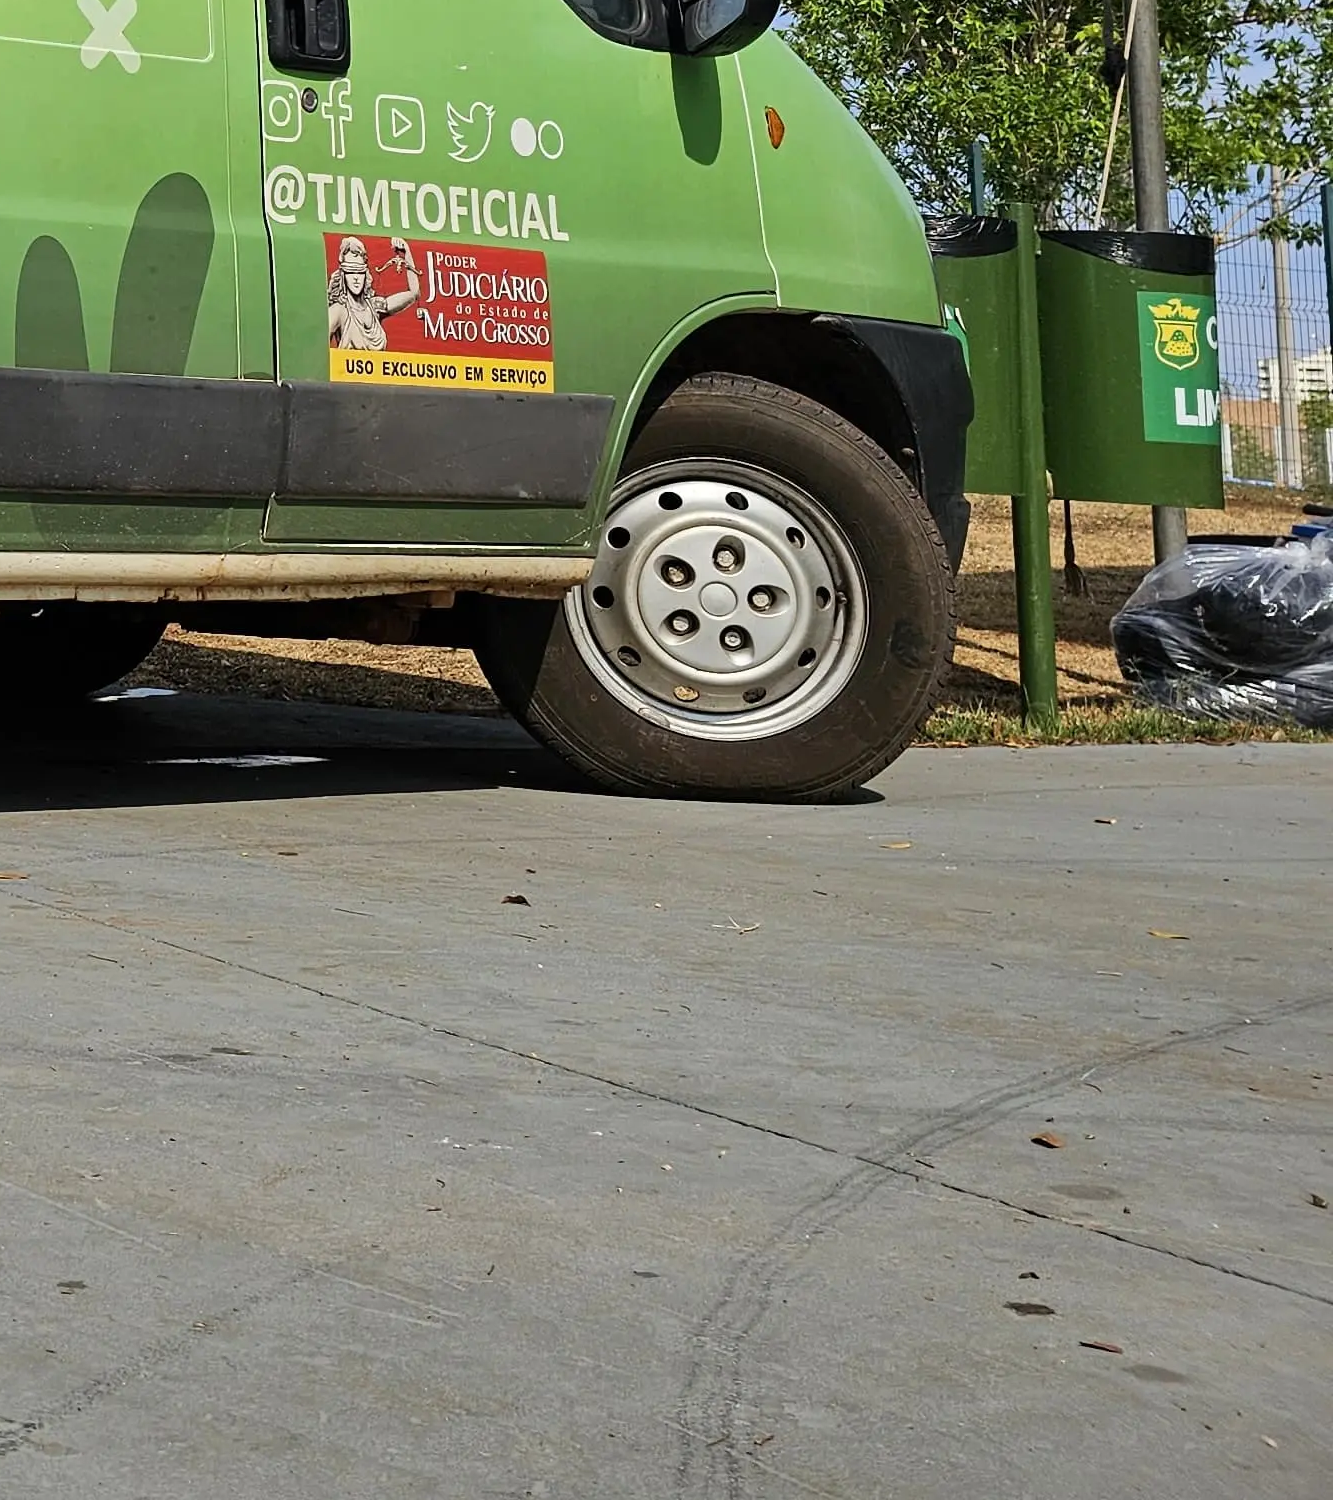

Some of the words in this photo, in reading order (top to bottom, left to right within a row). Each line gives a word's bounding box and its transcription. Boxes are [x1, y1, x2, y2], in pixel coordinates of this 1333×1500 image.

[266, 166, 569, 241] @TJMTOFICIAL
[425, 251, 548, 304] JUDICIÁRIO
[436, 252, 477, 270] PODER
[456, 303, 471, 315] do
[480, 303, 526, 318] Estado
[534, 308, 549, 320] de
[423, 310, 477, 343] MATO
[481, 317, 550, 347] GROSSO
[345, 359, 374, 375] USO
[382, 361, 457, 380] EXCLUSIVO
[465, 367, 484, 382] EM
[491, 368, 547, 388] SERVIÇO
